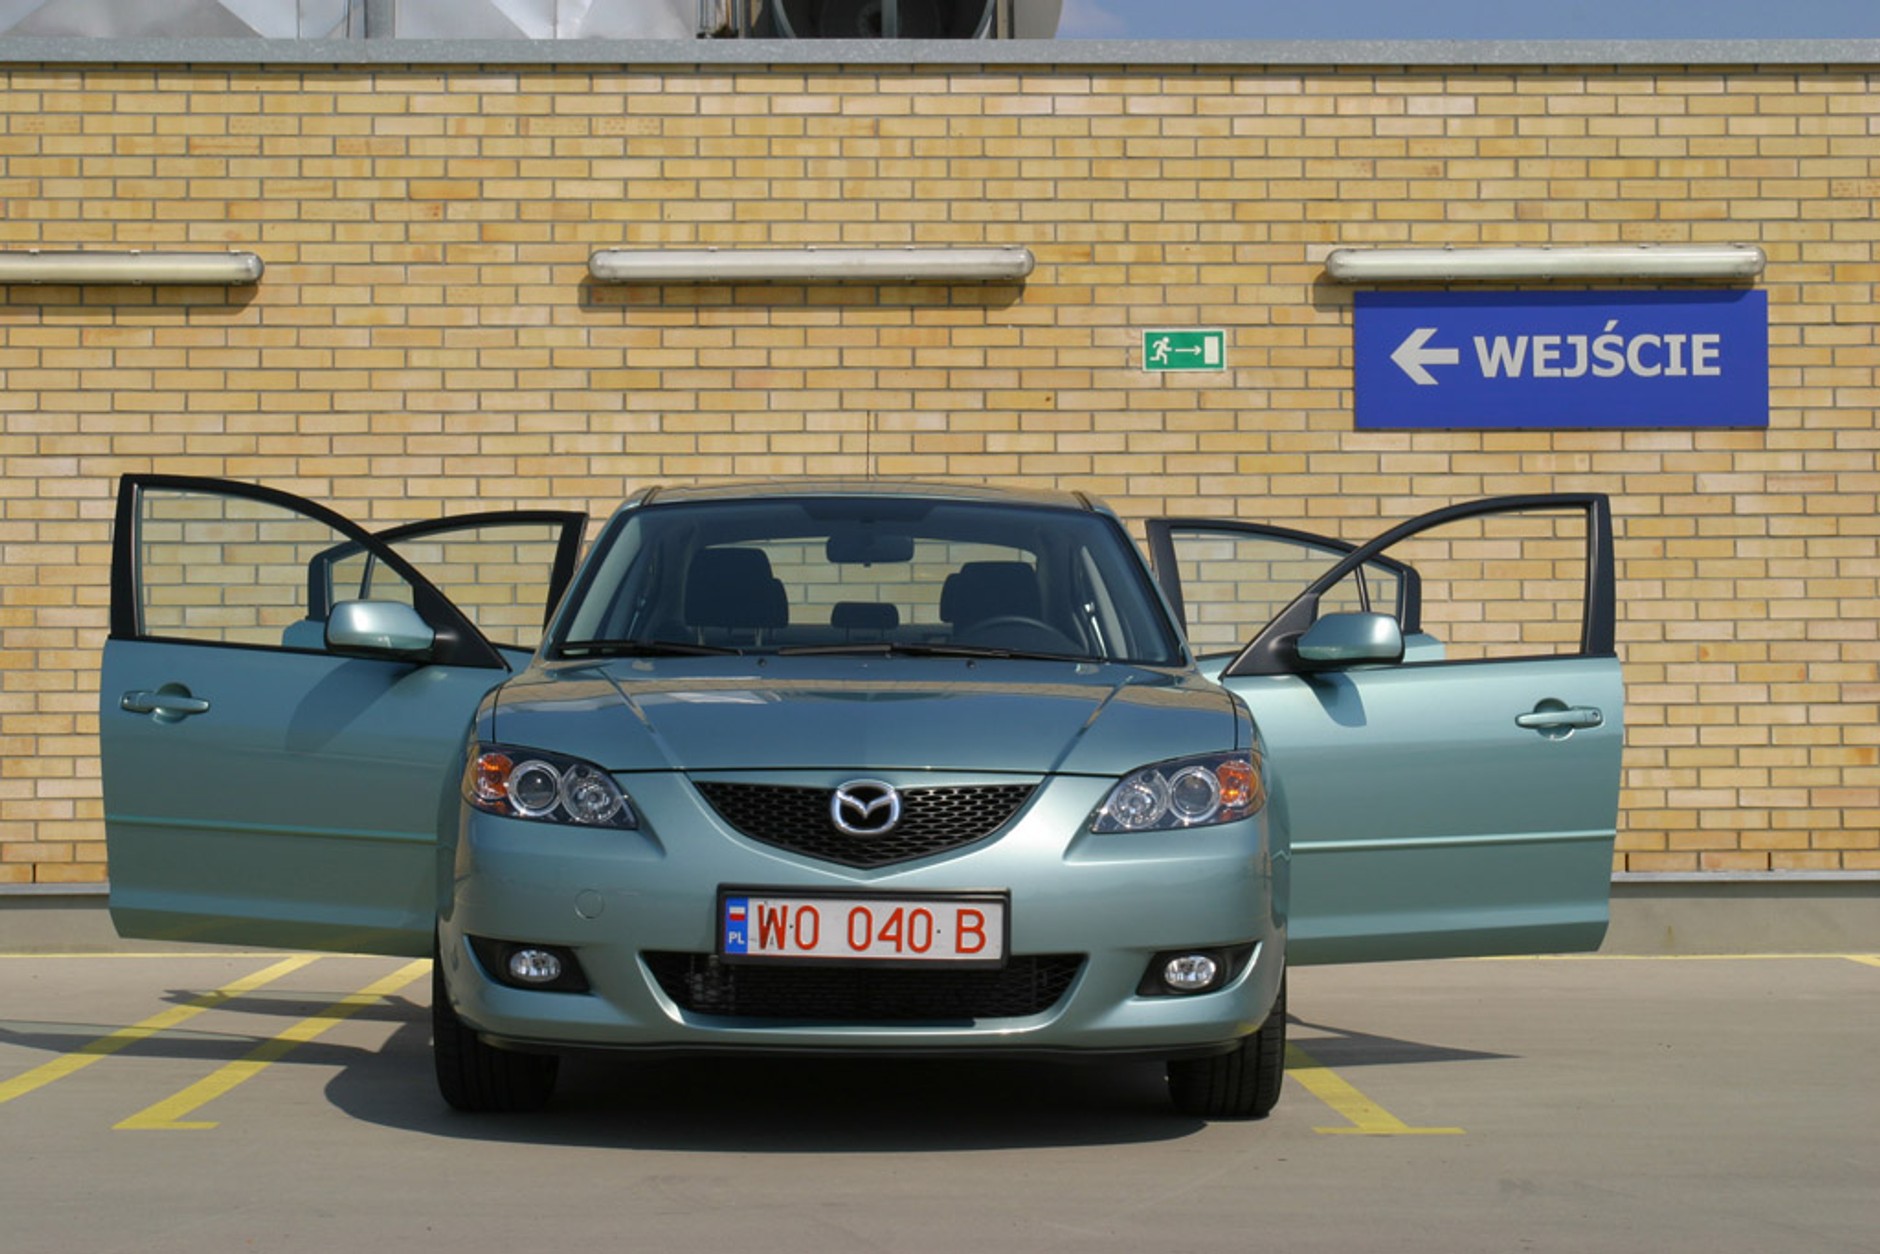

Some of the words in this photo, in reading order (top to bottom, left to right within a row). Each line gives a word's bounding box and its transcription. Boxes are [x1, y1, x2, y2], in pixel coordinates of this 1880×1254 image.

[1473, 319, 1721, 378] WEJŚCIE
[728, 933, 745, 945] PL
[757, 904, 820, 950] WO
[847, 906, 933, 953] 040
[955, 908, 987, 954] B
